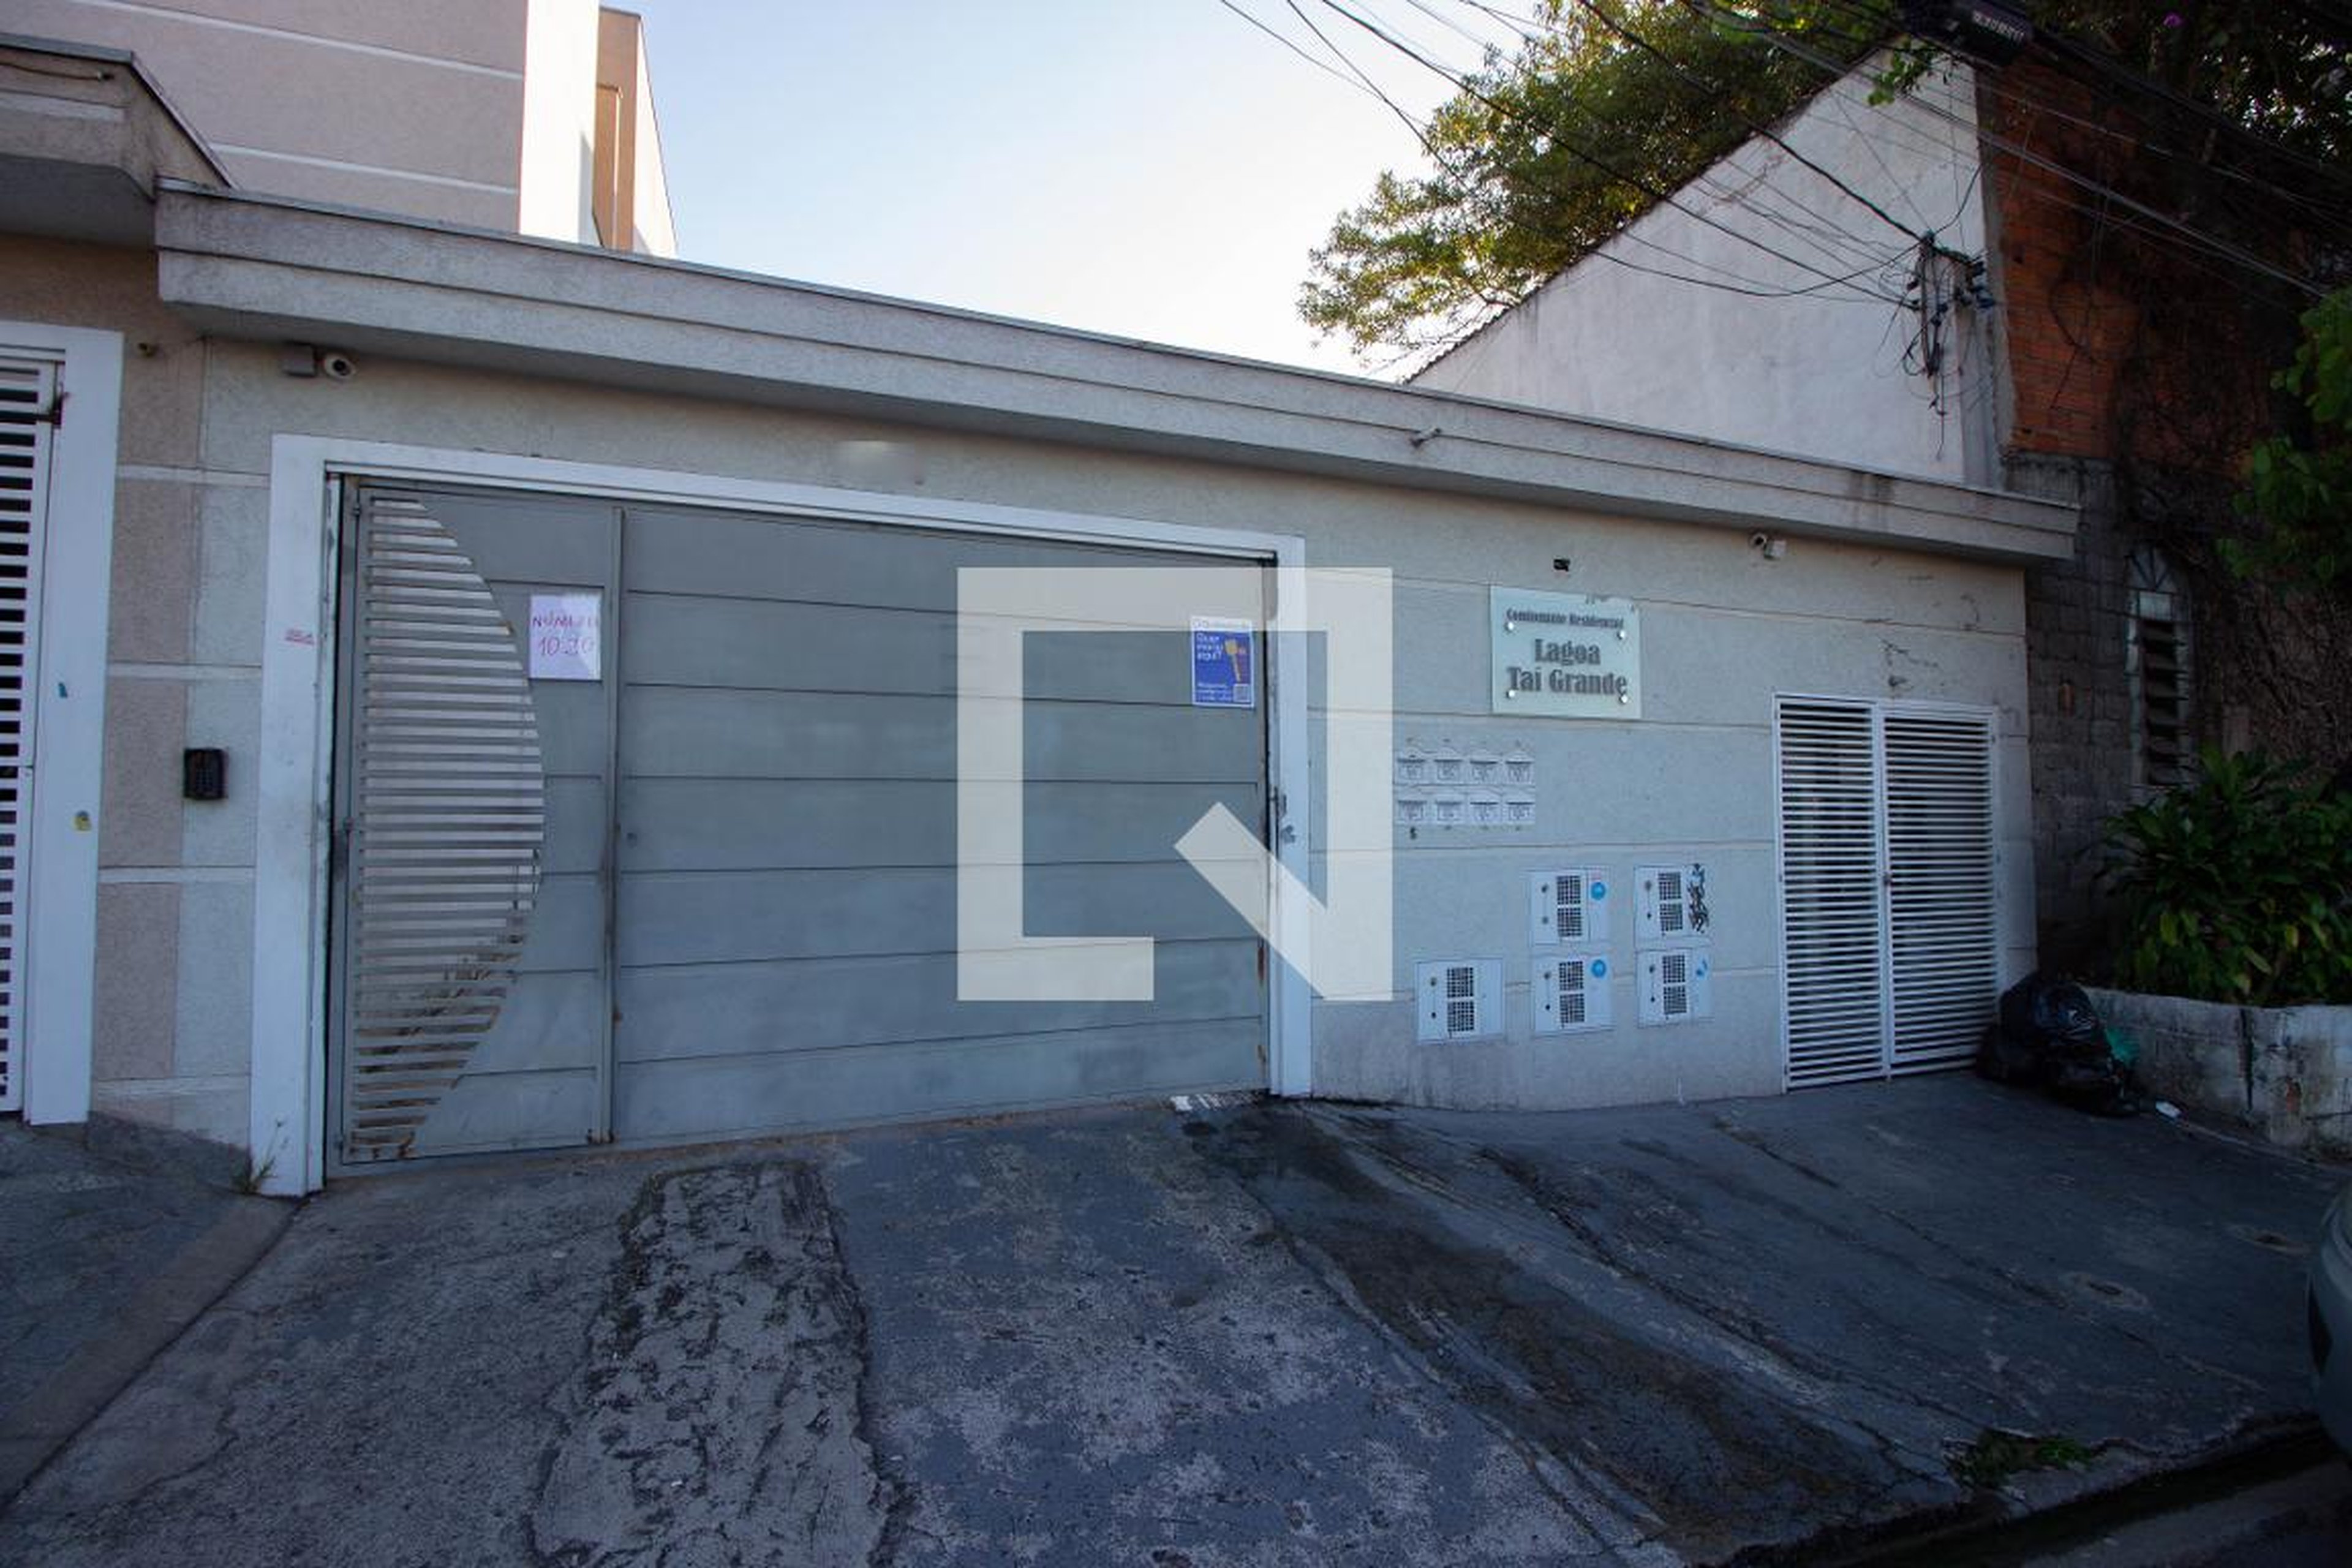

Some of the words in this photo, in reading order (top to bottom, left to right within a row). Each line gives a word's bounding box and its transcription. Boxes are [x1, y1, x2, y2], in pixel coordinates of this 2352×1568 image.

[1534, 638, 1601, 666] Lagoa
[1507, 666, 1542, 692] Tai
[1548, 669, 1627, 695] Grande
